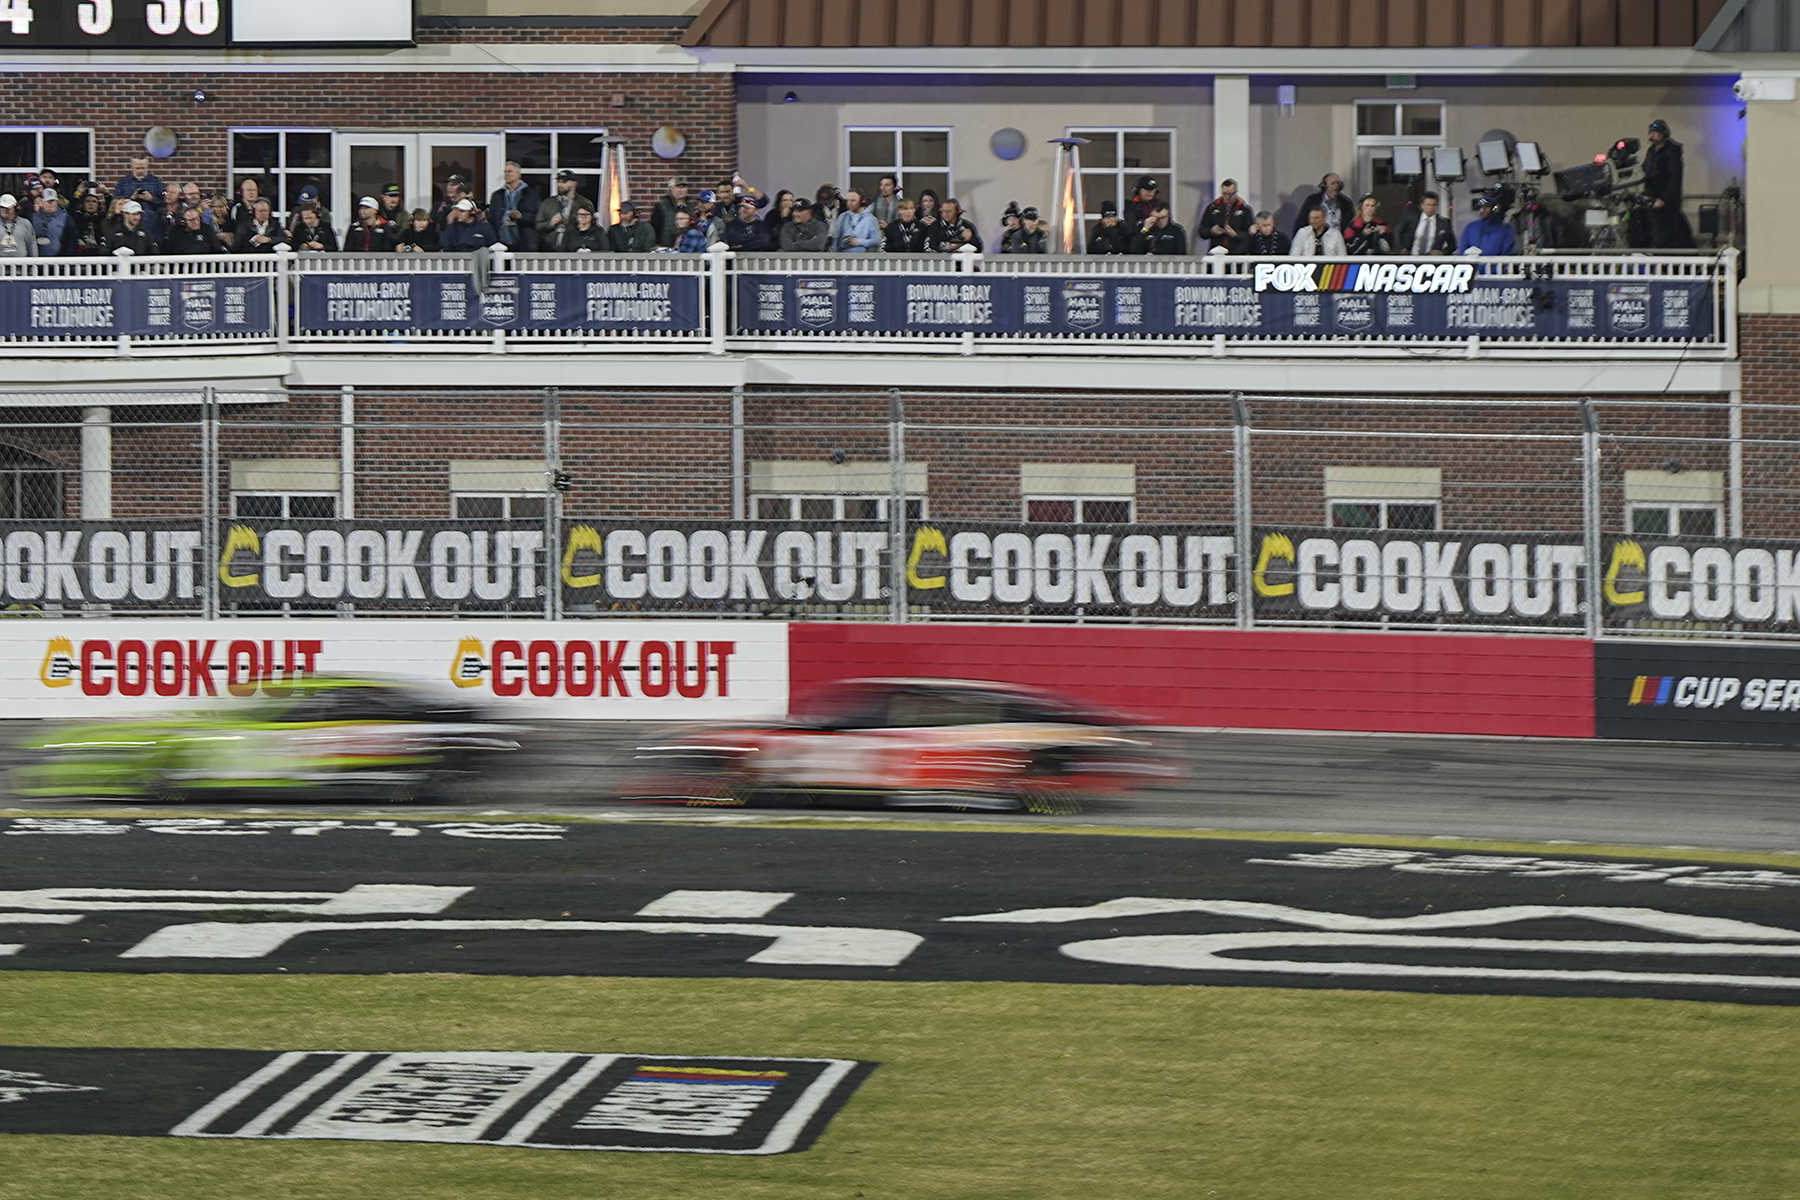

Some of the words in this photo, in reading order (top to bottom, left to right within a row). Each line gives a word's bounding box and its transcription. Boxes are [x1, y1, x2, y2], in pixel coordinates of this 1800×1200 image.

[1254, 263, 1319, 292] FOX
[1353, 263, 1475, 294] NASCAR
[30, 288, 112, 305] BOWMAN-GRAY
[327, 282, 410, 299] BOWMAN-GRAY
[586, 282, 670, 299] BOWMAN-GRAY
[801, 296, 832, 306] HALL
[907, 284, 991, 301] BOWMAN-GRAY
[1068, 297, 1098, 307] HALL
[185, 299, 212, 308] HALL
[327, 299, 411, 322] FIELDHOUSE
[484, 307, 515, 316] FAME
[586, 299, 671, 322] FIELDHOUSE
[801, 308, 833, 318] FAME
[907, 301, 993, 325] FIELDHOUSE
[1067, 310, 1099, 320] FAME
[1174, 303, 1262, 327] FIELDHOUSE
[1337, 299, 1369, 308] HALL
[1612, 301, 1644, 311] HALL
[30, 305, 114, 328] FIELDHOUSE
[185, 311, 213, 321] FAME
[1337, 312, 1370, 322] FAME
[1447, 304, 1535, 329] FIELDHOUSE
[1612, 313, 1645, 325] FAME
[89, 531, 202, 601] OUT
[262, 530, 424, 599] COOK
[430, 530, 544, 600] OUT
[605, 530, 769, 599] COOK
[774, 531, 889, 601] OUT
[950, 532, 1116, 605] COOK
[1119, 534, 1237, 607] OUT
[1299, 538, 1464, 614] COOK
[1468, 542, 1586, 618] OUT
[1648, 545, 1800, 624] COOK
[81, 639, 219, 698] COOK
[226, 639, 324, 697] OUT
[499, 639, 634, 699] COOK
[640, 640, 736, 698] OUT
[1672, 676, 1742, 709] CUP
[1740, 678, 1800, 712] SER
